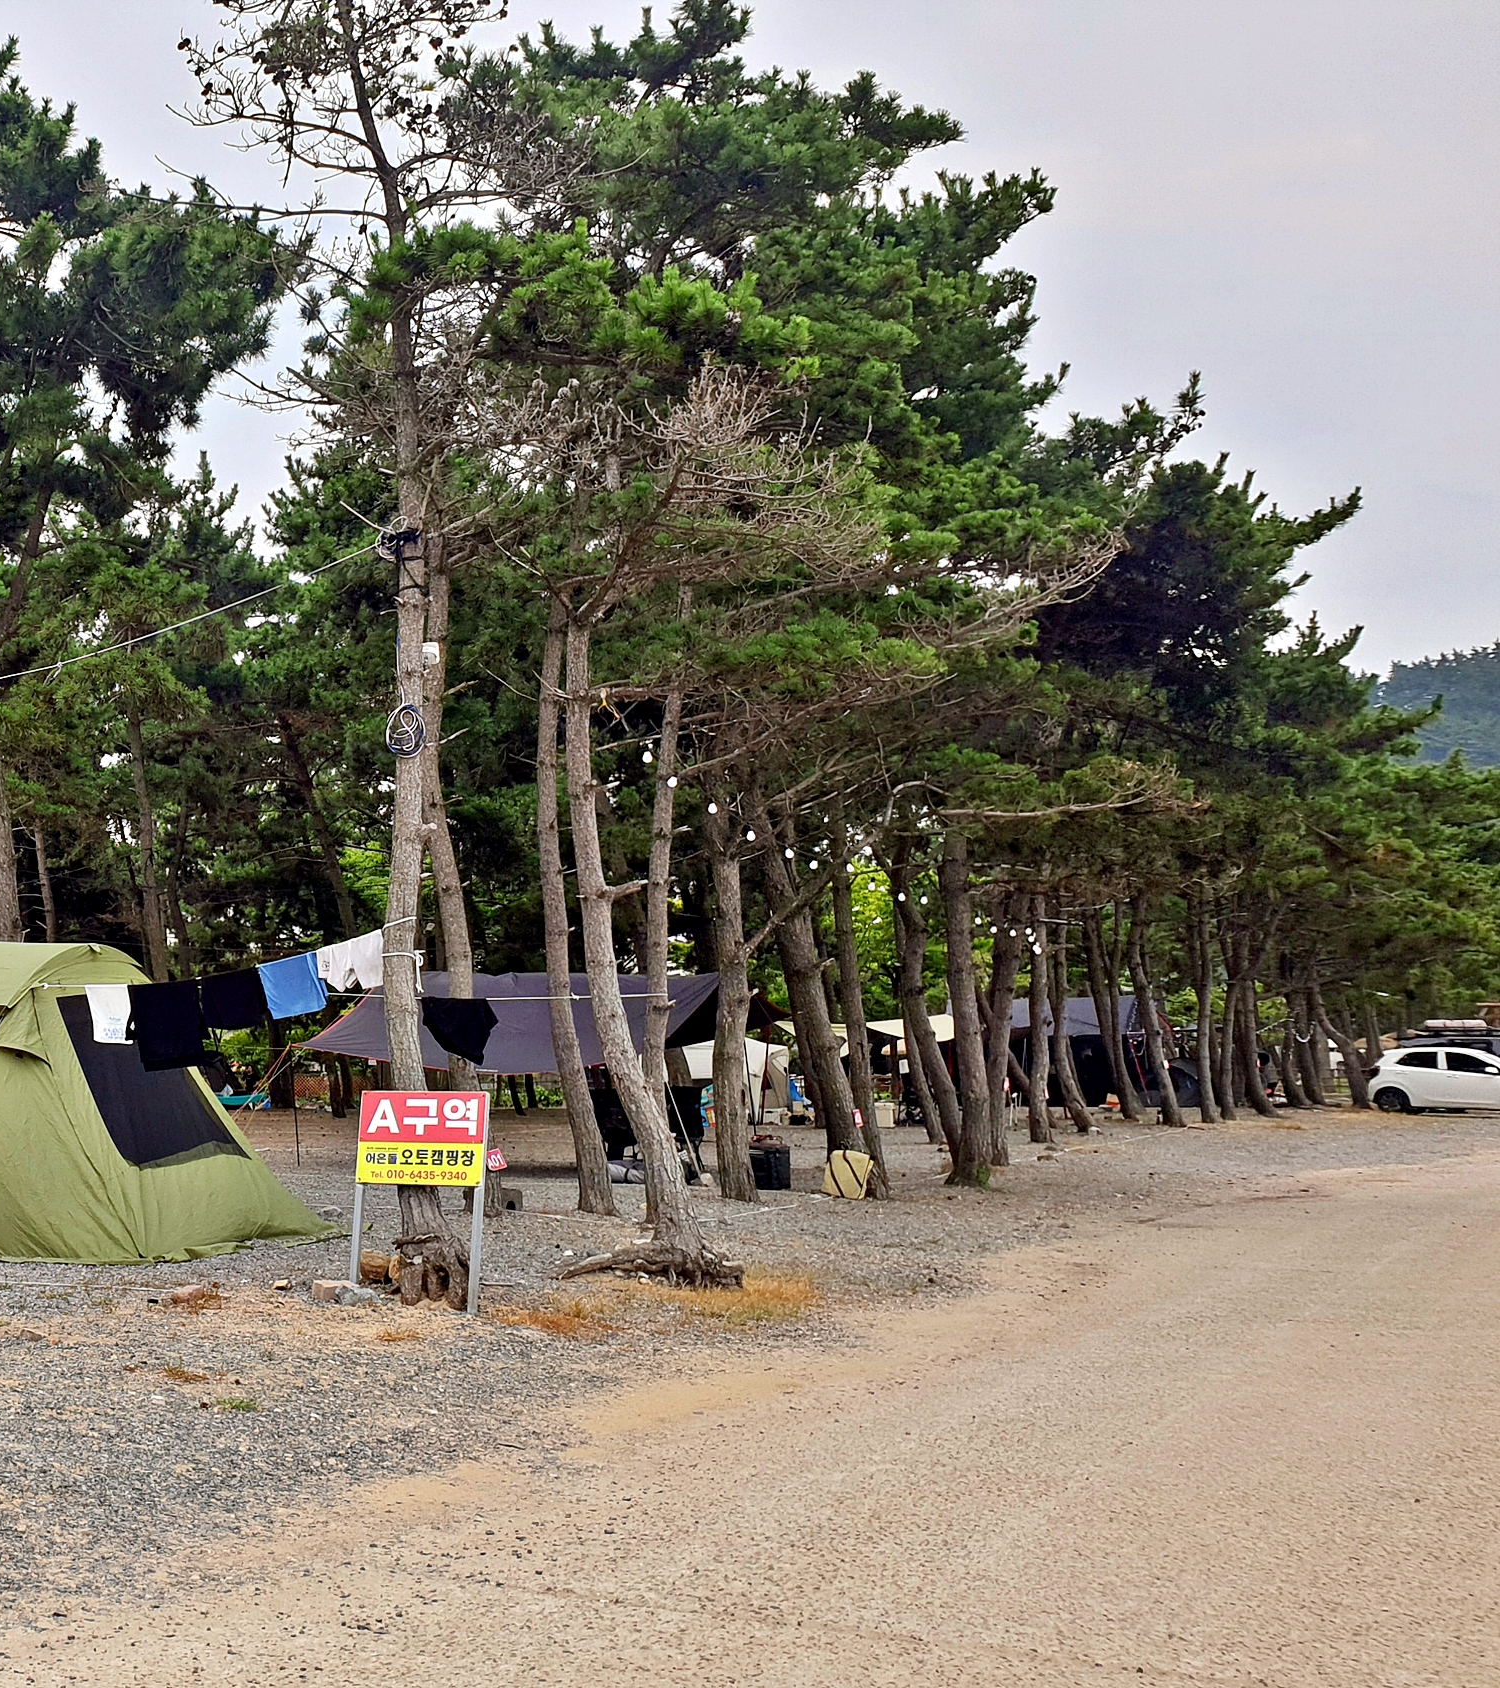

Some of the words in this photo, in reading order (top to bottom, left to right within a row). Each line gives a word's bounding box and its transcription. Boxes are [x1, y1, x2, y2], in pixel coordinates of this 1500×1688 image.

[366, 1098, 479, 1136] A구역
[400, 1149, 475, 1167] 오토캠핑장
[487, 1153, 505, 1169] A01
[370, 1171, 384, 1179] Tel.
[386, 1169, 468, 1181] 010-6435-9340
